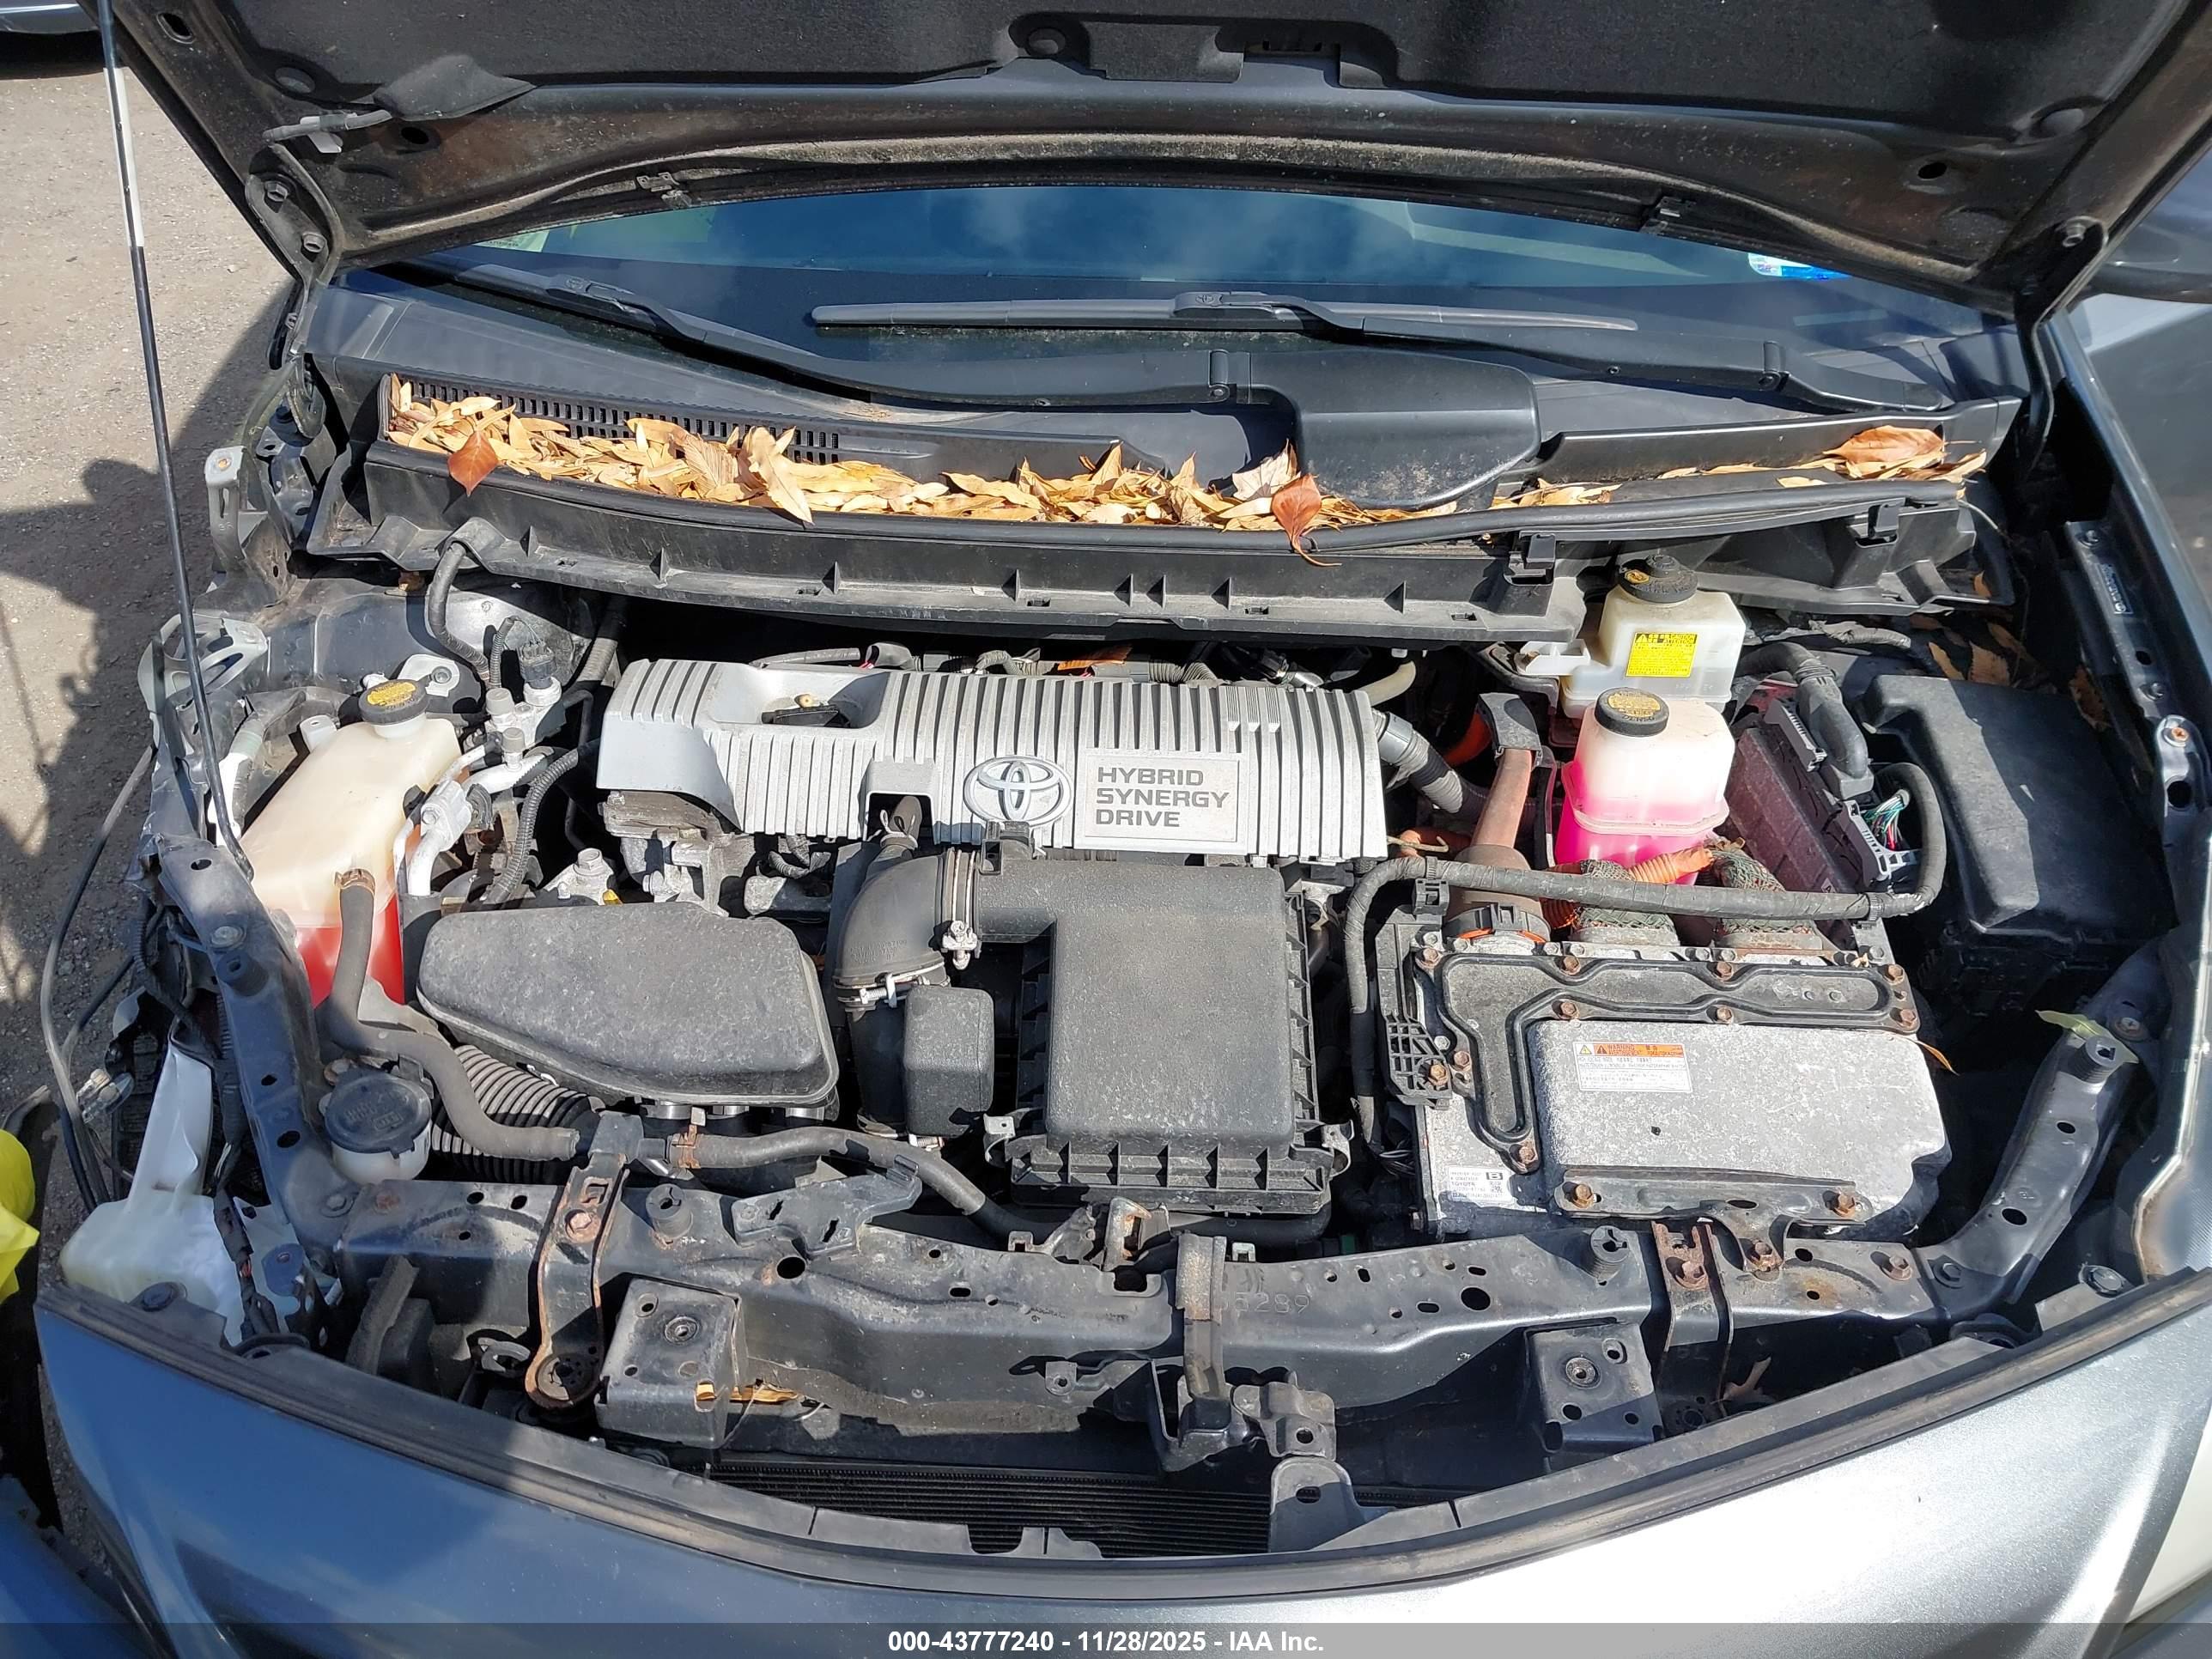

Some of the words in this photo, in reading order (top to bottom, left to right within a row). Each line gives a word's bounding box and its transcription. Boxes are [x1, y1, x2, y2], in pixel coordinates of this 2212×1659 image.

[1097, 767, 1204, 786] HYBRID
[1097, 787, 1230, 808] SYNERGY
[1096, 809, 1181, 827] DRIVE
